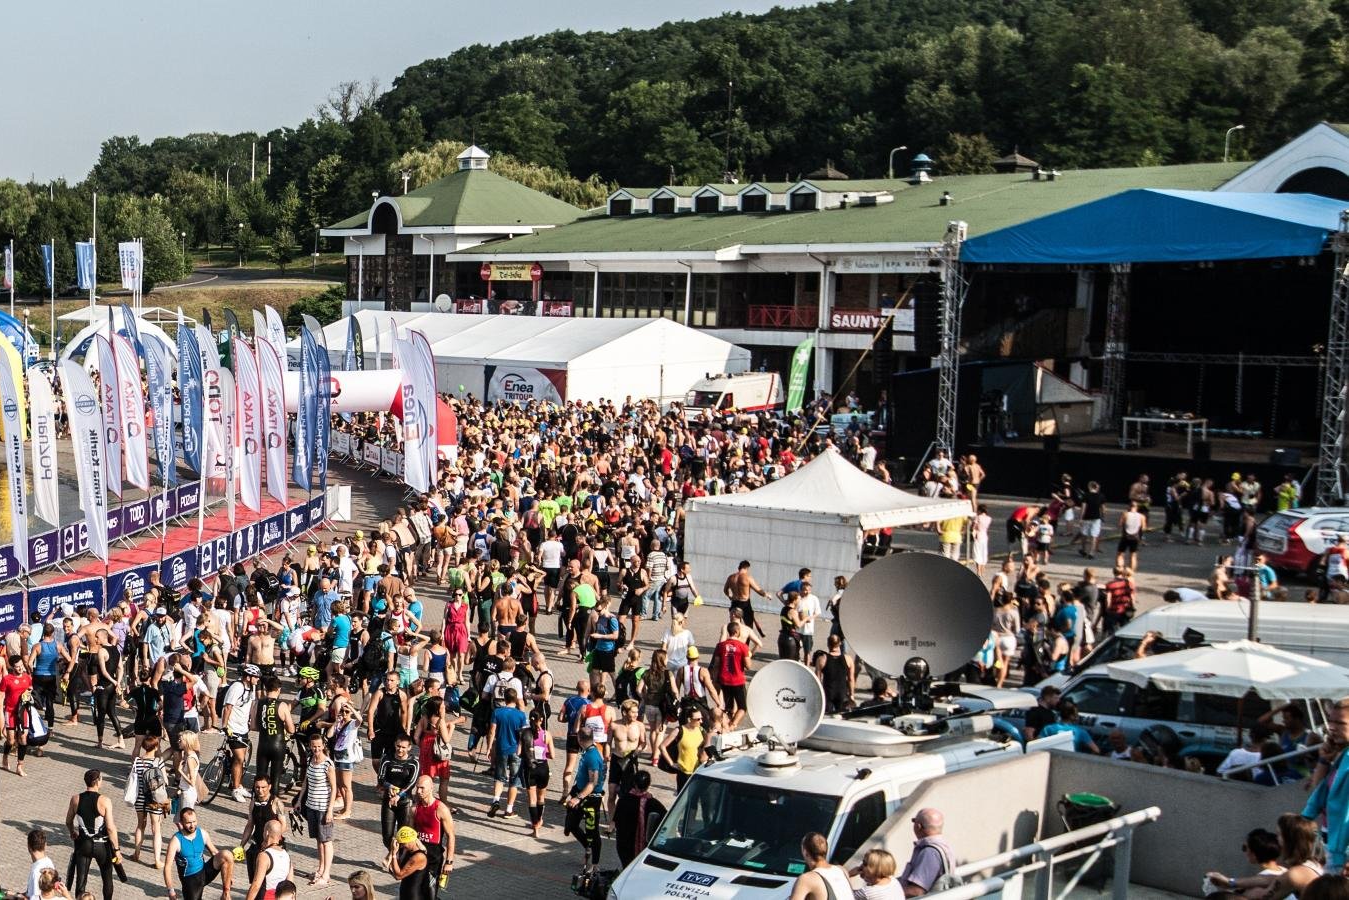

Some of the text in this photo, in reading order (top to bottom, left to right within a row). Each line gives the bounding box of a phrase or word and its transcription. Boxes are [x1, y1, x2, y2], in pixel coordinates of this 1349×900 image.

[832, 314, 880, 329] SAUNY
[504, 380, 534, 393] Enea
[129, 504, 145, 523] TODO
[34, 543, 48, 555] Enea
[173, 563, 186, 575] Enea
[125, 578, 144, 590] Enea
[52, 590, 94, 605] Firma Karlik
[685, 873, 711, 884] TVP
[664, 890, 698, 900] POLSKA
[665, 882, 710, 896] TELEWIZJA
